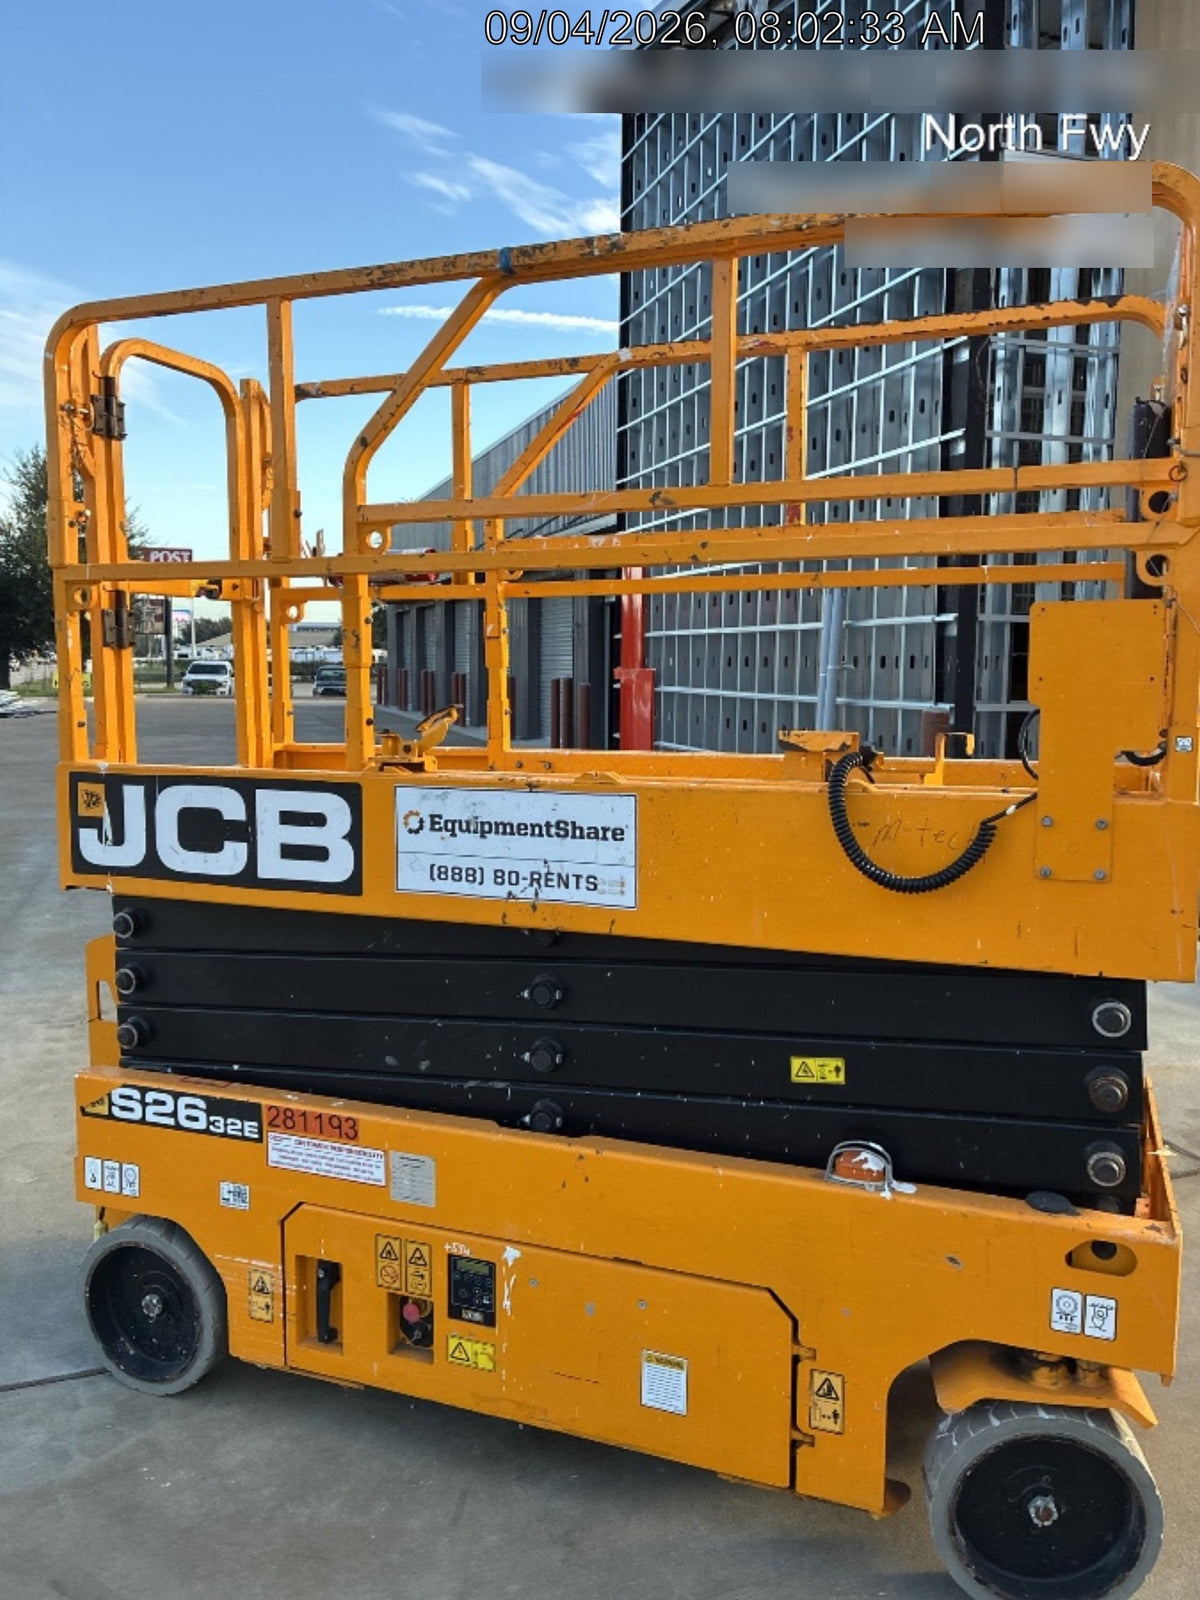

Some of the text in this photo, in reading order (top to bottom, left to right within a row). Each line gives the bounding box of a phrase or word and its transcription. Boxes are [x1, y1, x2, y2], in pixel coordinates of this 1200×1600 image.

[149, 550, 191, 563] POST
[78, 783, 355, 884] JCB
[429, 813, 626, 842] EquipmentShare
[429, 863, 484, 887] (888)
[493, 868, 599, 892] 80-RENTS
[110, 1087, 260, 1139] S26 32E
[267, 1105, 359, 1141] 281193
